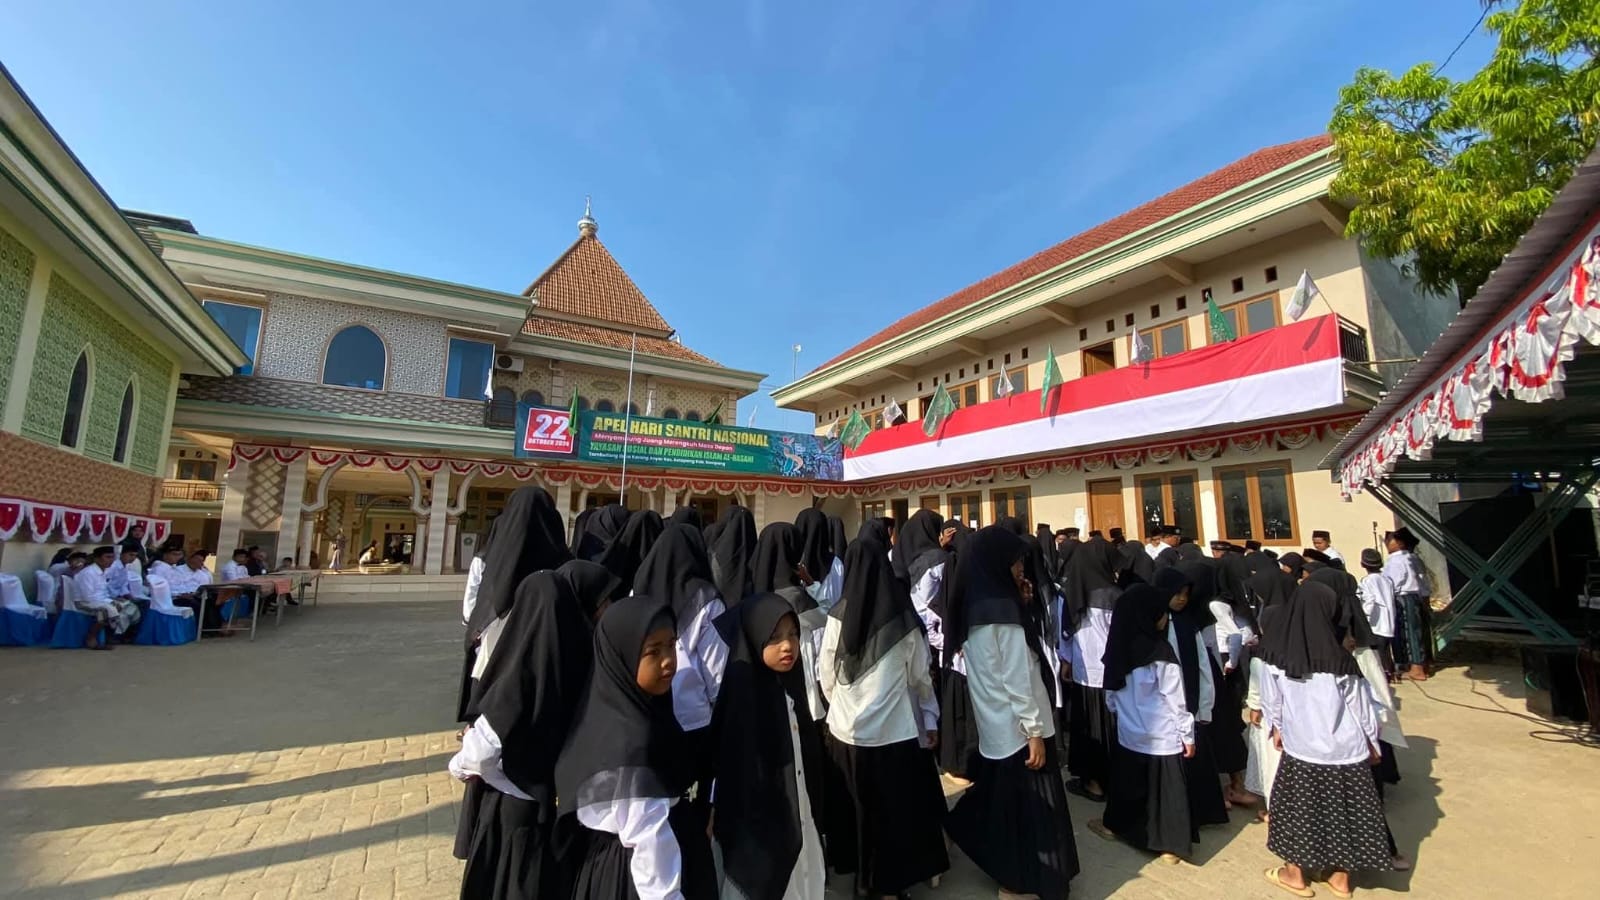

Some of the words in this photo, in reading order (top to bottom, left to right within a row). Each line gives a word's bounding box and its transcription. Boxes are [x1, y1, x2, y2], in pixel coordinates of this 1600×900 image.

[533, 415, 569, 439] 22
[593, 417, 627, 431] APEL
[630, 421, 662, 435] HARI
[665, 424, 711, 440] SANTRI
[714, 430, 768, 446] NASIONAL
[590, 441, 621, 452] YAYASAN
[649, 446, 663, 456] DAN
[664, 447, 703, 459] PENDIDIKAN
[704, 451, 722, 461] ISLAM
